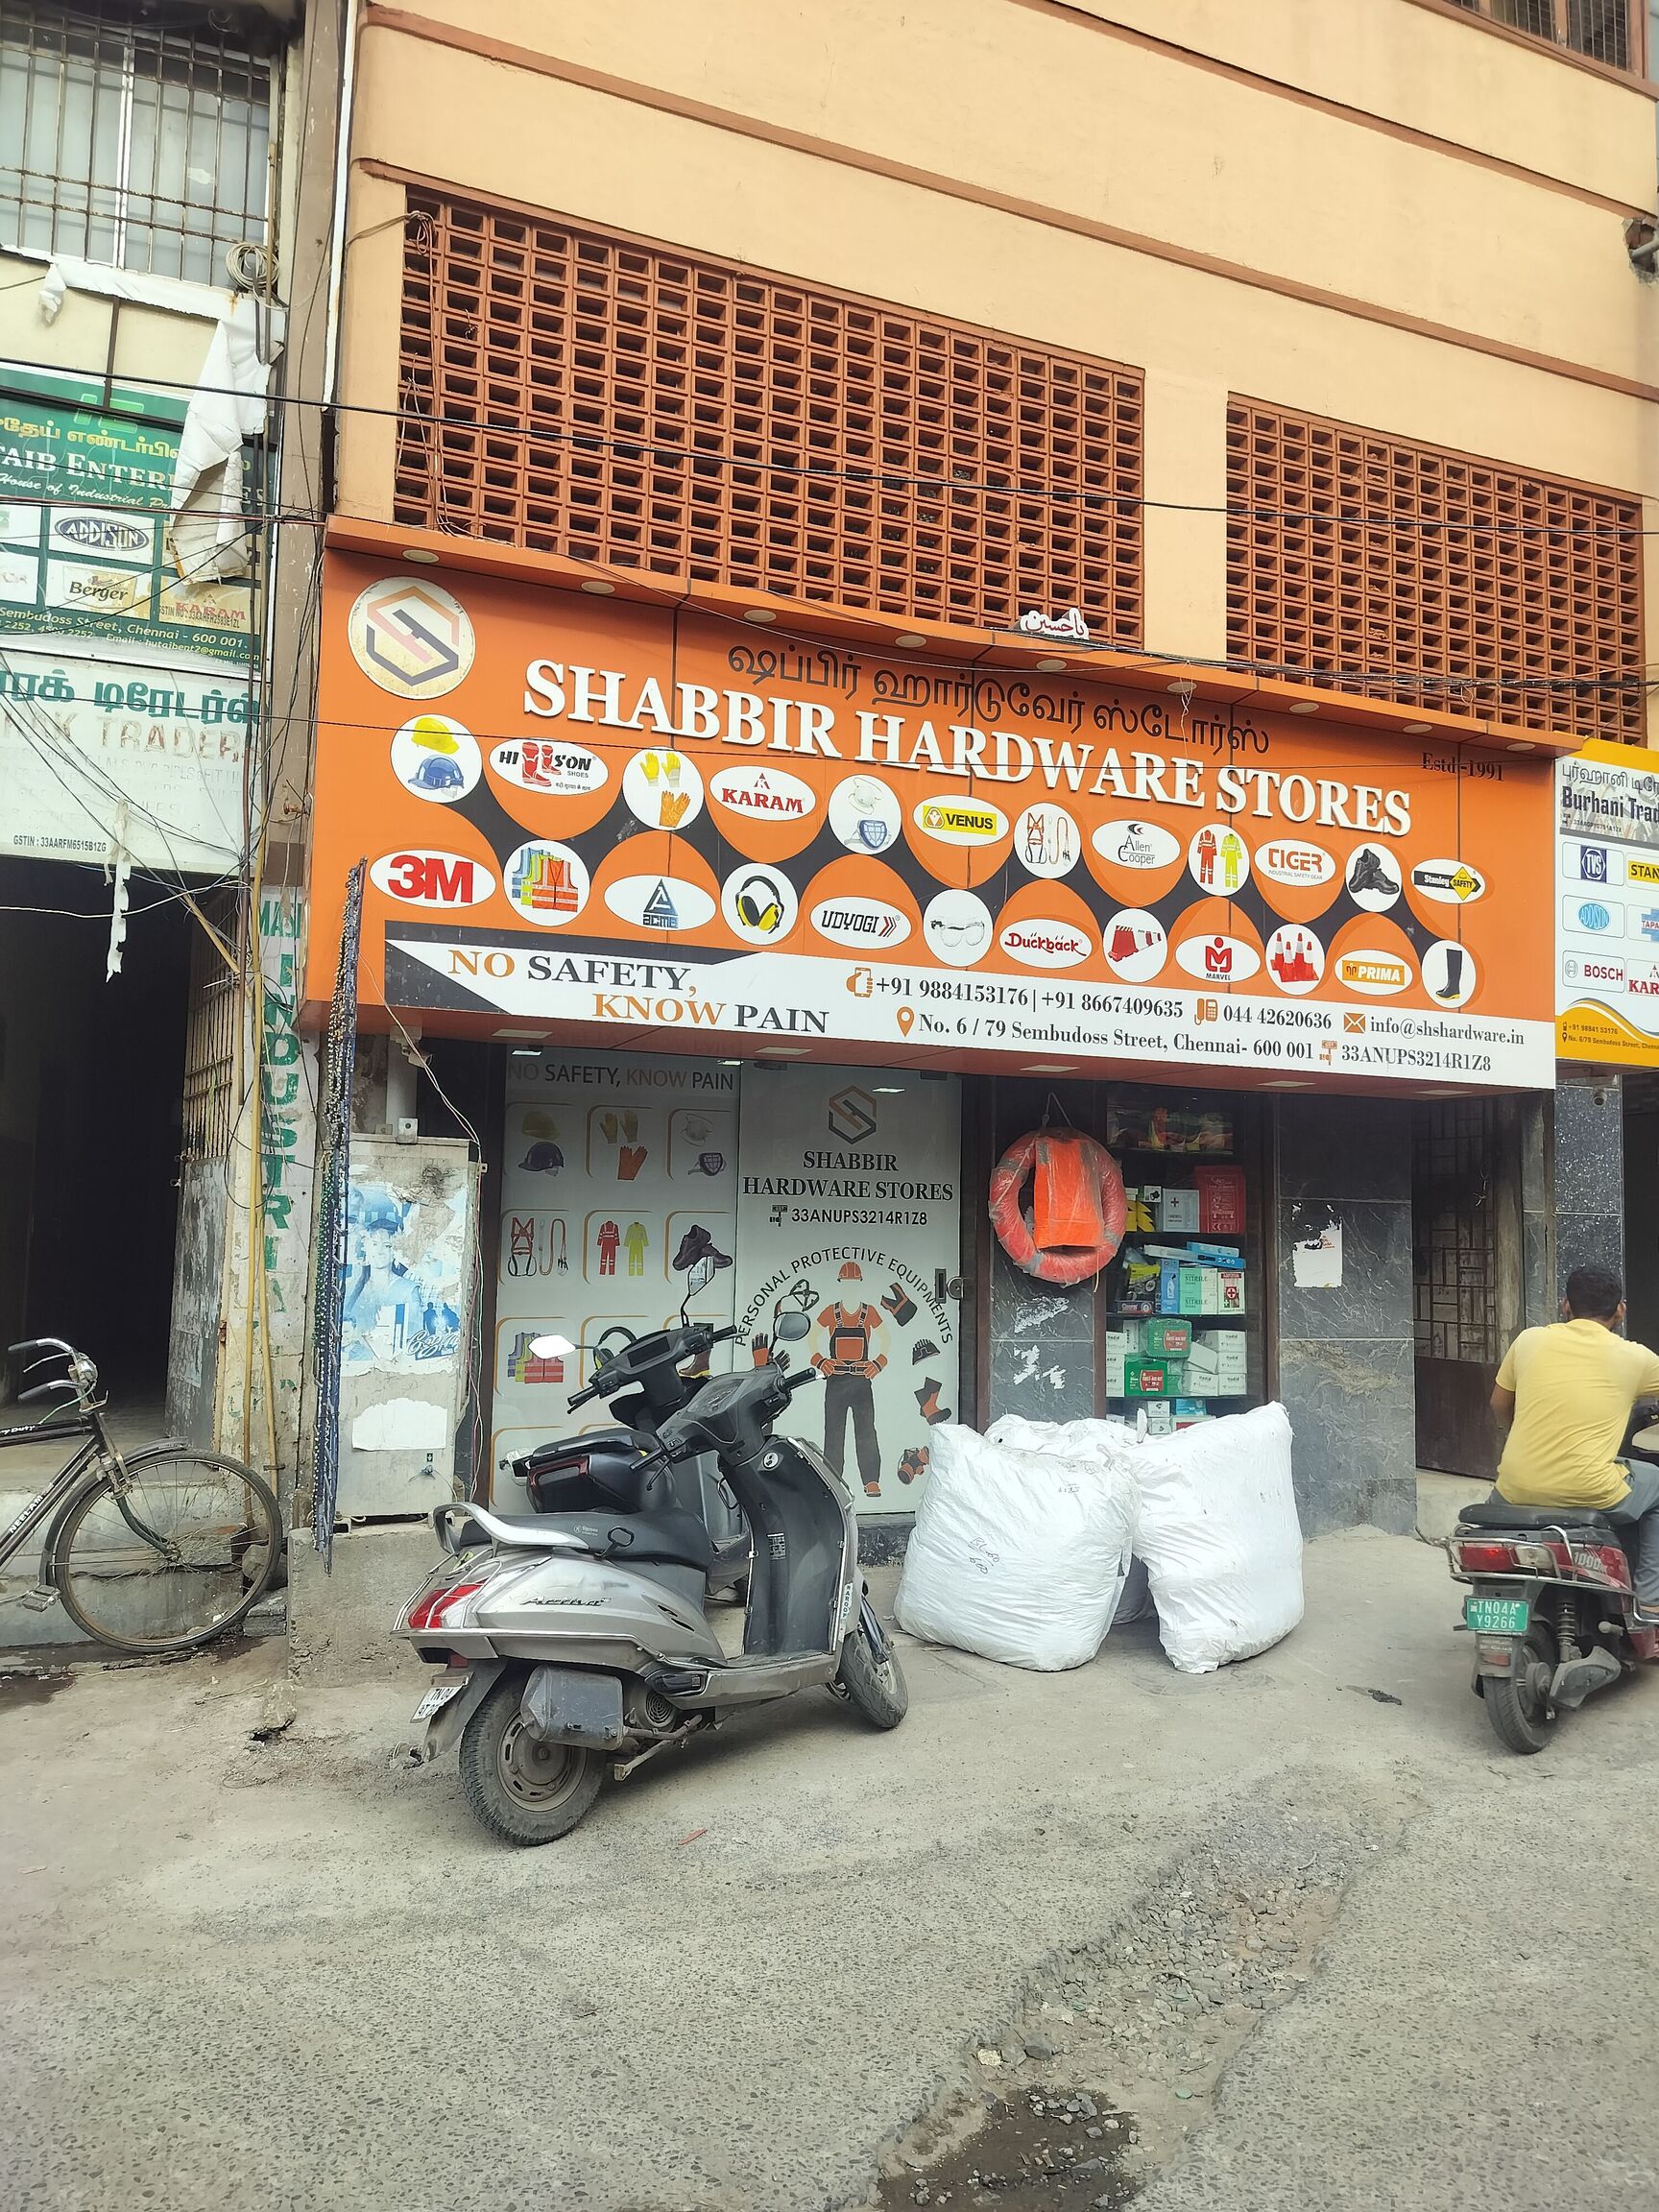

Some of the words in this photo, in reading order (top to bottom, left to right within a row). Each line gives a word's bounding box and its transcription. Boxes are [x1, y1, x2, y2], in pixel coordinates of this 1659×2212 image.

[47, 483, 62, 495] of
[68, 484, 143, 506] Industrial
[60, 519, 141, 550] ADDISON
[69, 581, 129, 601] Berger
[175, 602, 246, 621] KARAM
[0, 607, 72, 625] Sembudoss
[127, 624, 180, 639] Chennai
[192, 634, 216, 644] 600
[524, 659, 842, 758] SHABBIR
[854, 710, 1206, 808] HARDWARE
[1215, 764, 1411, 837] STORES
[567, 770, 589, 779] SHOES
[722, 788, 805, 814] KARAM
[1562, 786, 1624, 817] Burhani
[946, 814, 994, 830] VENUS
[13, 835, 36, 847] GSTIN
[1124, 835, 1152, 854] Allen
[1118, 844, 1156, 867] Cooper
[1585, 854, 1602, 875] TVS
[387, 854, 473, 903] 3M
[1424, 875, 1450, 888] Stanley
[1453, 879, 1474, 889] SAFETY
[821, 910, 879, 933] UDYOGI
[447, 950, 516, 978] NO
[528, 955, 696, 997] SAFETY,
[1206, 973, 1231, 981] MARVEL
[1357, 965, 1401, 982] PRIMA
[1584, 964, 1623, 981] BOSCH
[591, 994, 726, 1026] KNOW
[733, 1003, 830, 1034] PAIN
[877, 977, 913, 998] +91
[920, 979, 1028, 1007] 9884153176
[1042, 992, 1075, 1010] +91
[1081, 993, 1184, 1019] 8667409635
[1223, 1005, 1252, 1024] 044
[1257, 1007, 1332, 1030] 42620636
[1370, 1016, 1526, 1046] info@shshardware.in
[919, 1013, 950, 1035] No.
[1011, 1022, 1109, 1046] Sembudoss
[1113, 1028, 1168, 1052] Street,
[1253, 1040, 1282, 1057] 600
[1286, 1043, 1314, 1059] 001
[1341, 1045, 1491, 1071] 33ANUPS3214R1Z8
[507, 1061, 539, 1081] NO
[544, 1064, 621, 1088] SAFETY,
[626, 1069, 686, 1088] KNOW
[692, 1071, 733, 1091] PAIN
[803, 1151, 899, 1171] SHABBIR
[743, 1177, 871, 1198] HARDWARE
[875, 1181, 953, 1201] STORES
[791, 1209, 927, 1226] 33ANUPS3214R1Z8
[734, 1269, 791, 1346] PERSONAL
[790, 1246, 886, 1273] PROTECTIVE
[888, 1259, 953, 1344] EQUIPMENTS
[1477, 1616, 1515, 1629] Y9266
